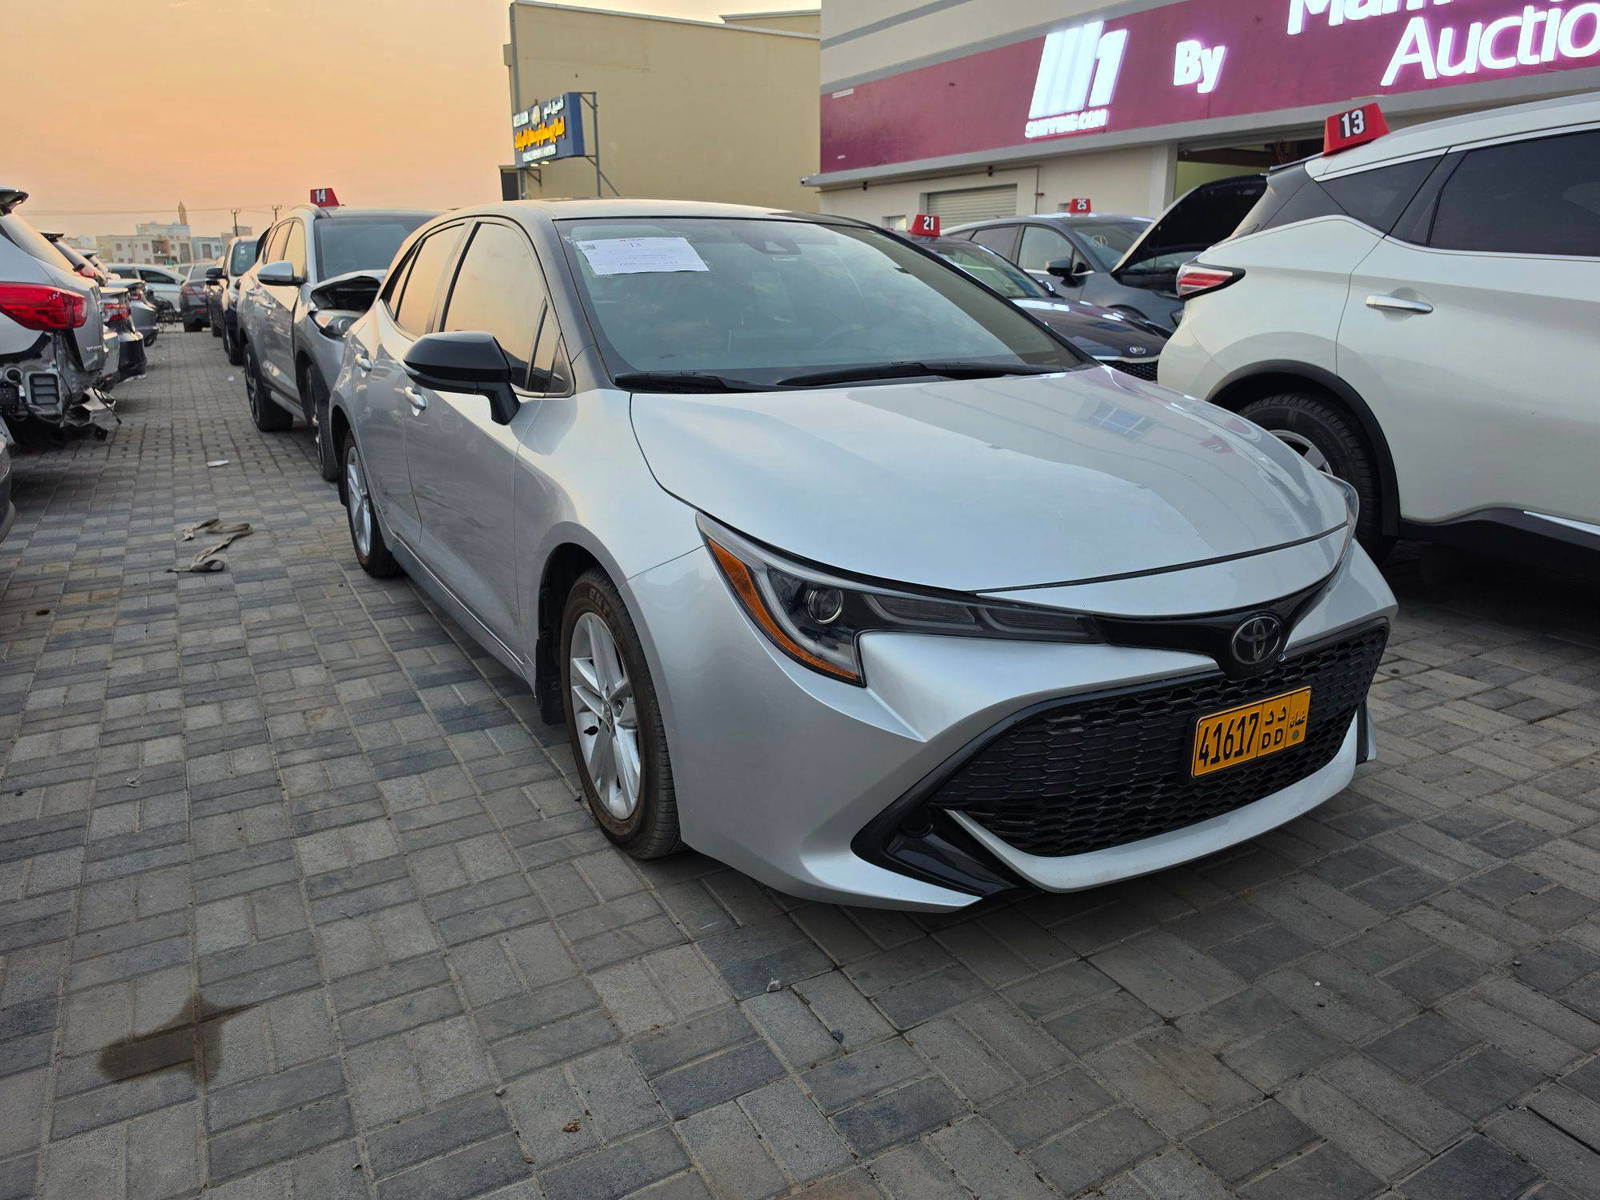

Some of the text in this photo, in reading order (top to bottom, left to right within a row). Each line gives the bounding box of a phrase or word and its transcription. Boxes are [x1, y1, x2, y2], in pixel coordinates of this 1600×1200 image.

[1174, 40, 1227, 93] By
[1341, 109, 1365, 138] 13
[315, 189, 327, 203] 14
[1077, 199, 1087, 210] 25
[923, 216, 934, 231] 21
[1198, 711, 1260, 767] 41617
